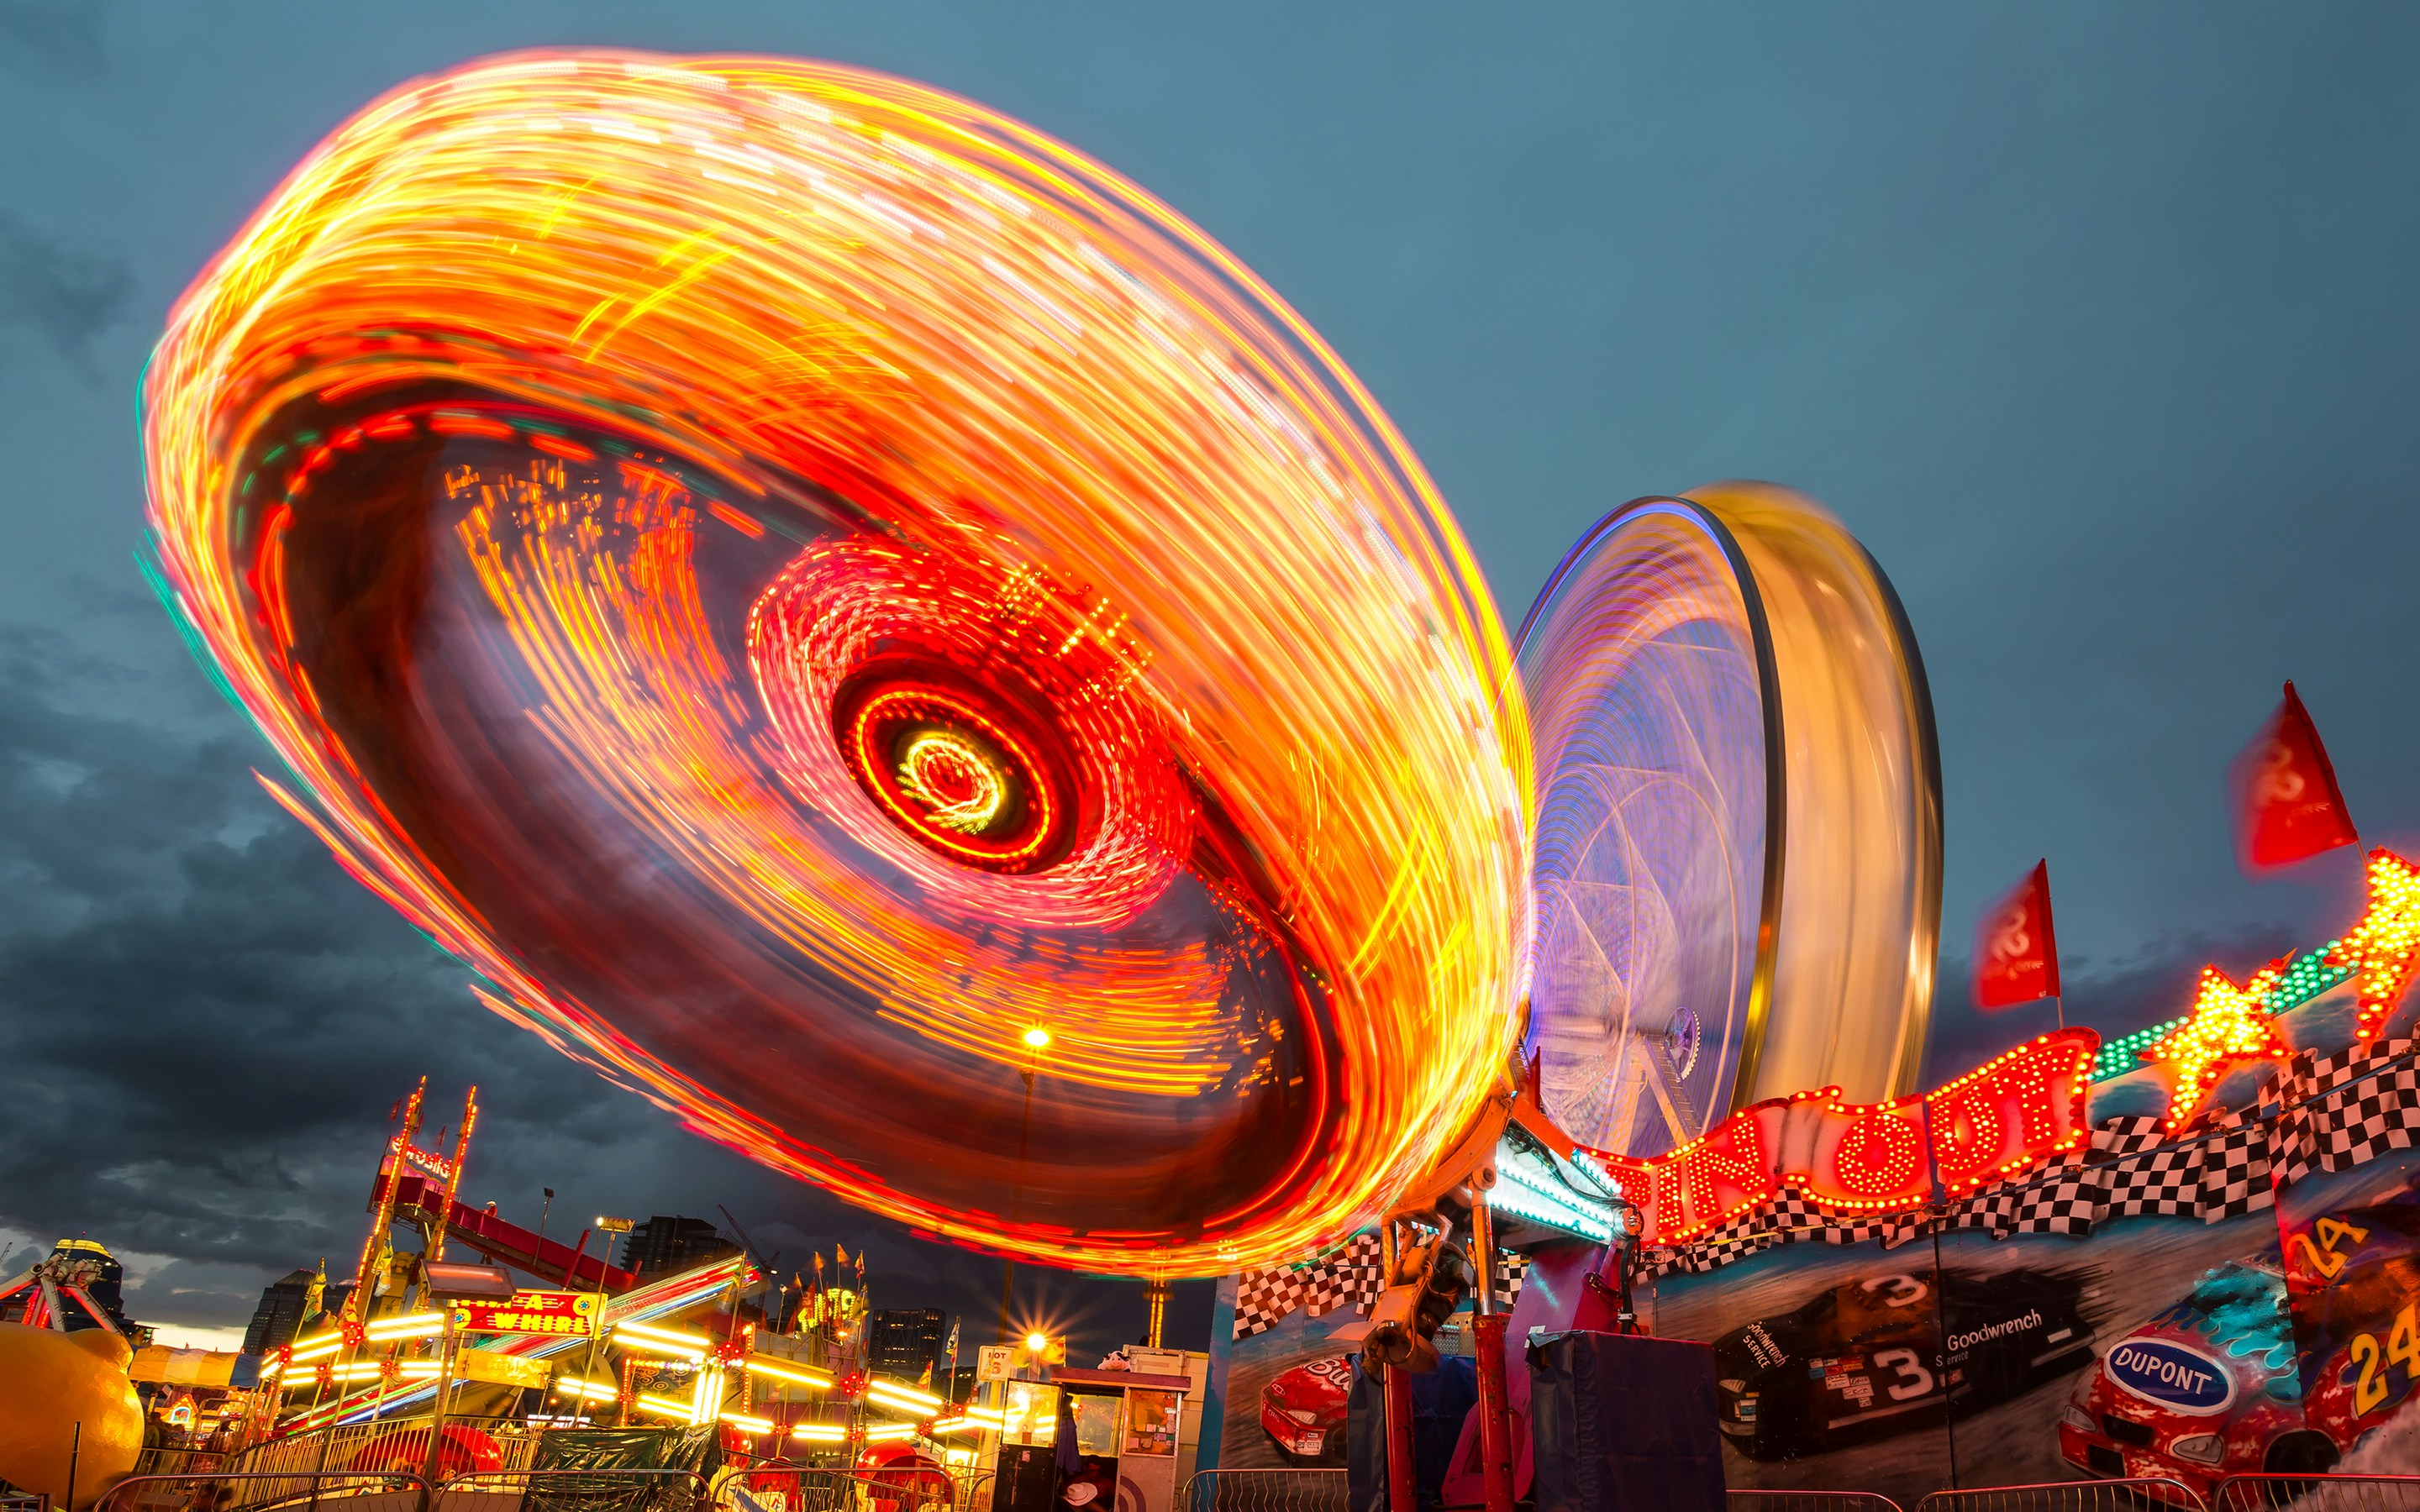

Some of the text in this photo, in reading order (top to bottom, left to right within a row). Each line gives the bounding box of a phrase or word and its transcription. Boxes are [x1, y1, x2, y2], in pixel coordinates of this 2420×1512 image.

[1834, 1045, 2078, 1194] OUT
[2286, 1217, 2370, 1279] 24
[1861, 1275, 1928, 1308] 3
[494, 1313, 587, 1334] WHIRL
[1948, 1309, 2043, 1351] Goodwrench
[1743, 1335, 1770, 1369] SERVICE
[1874, 1348, 1933, 1400] 3
[2114, 1347, 2212, 1395] DUPONT
[2350, 1302, 2420, 1418] 24
